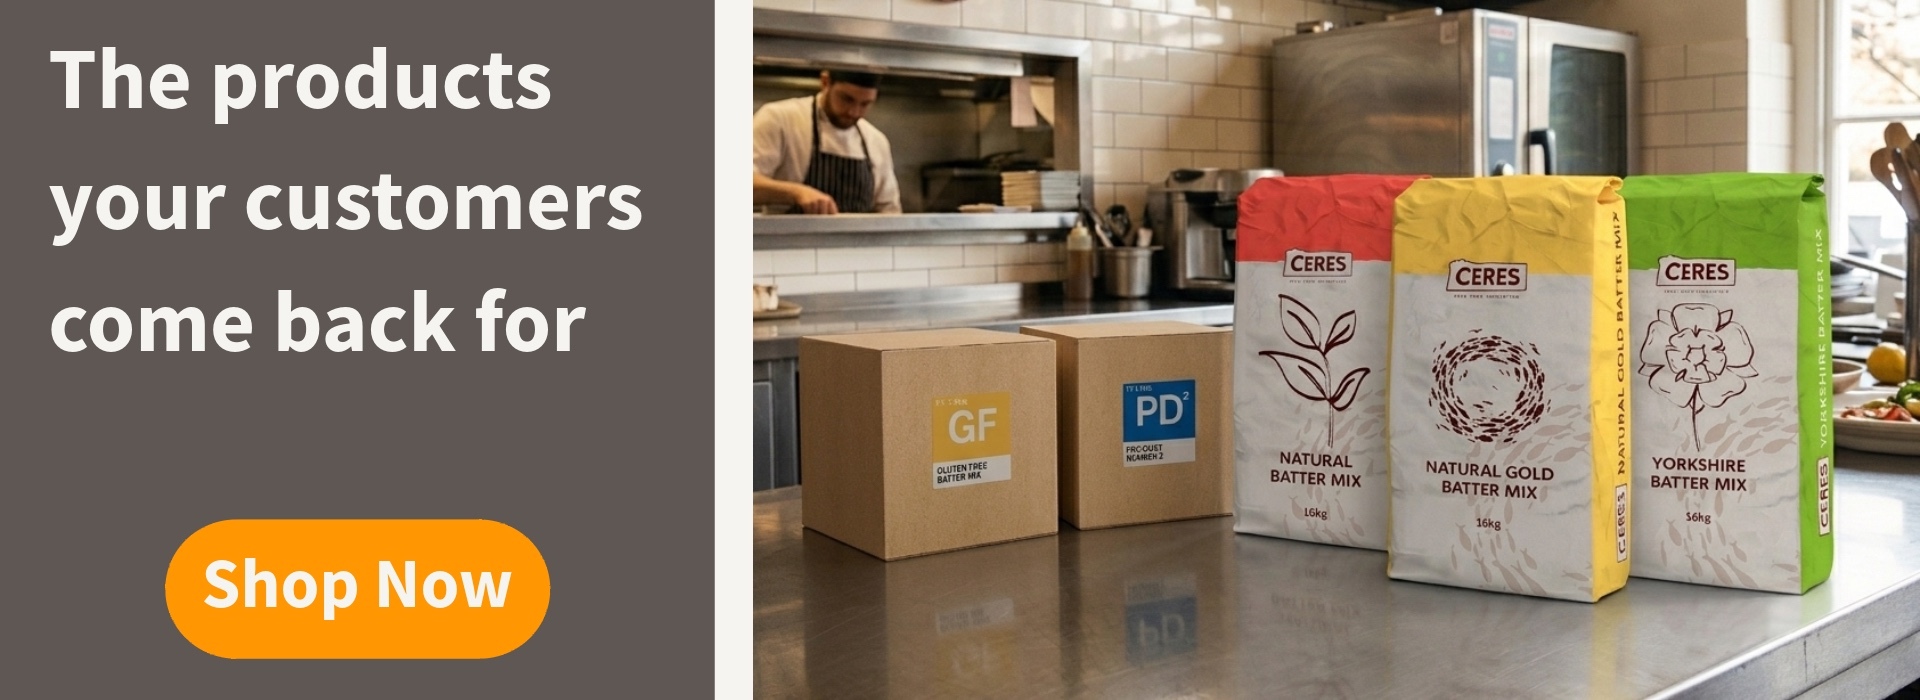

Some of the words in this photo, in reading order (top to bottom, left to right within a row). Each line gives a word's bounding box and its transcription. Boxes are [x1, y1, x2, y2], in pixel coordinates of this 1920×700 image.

[1290, 254, 1347, 272] CERES
[1665, 261, 1730, 281] CERES
[1455, 266, 1521, 286] CERES
[948, 407, 998, 444] GF
[1279, 451, 1354, 468] NATURAL
[1651, 456, 1747, 473] YORKSHIRE
[936, 473, 966, 484] BATTER
[1270, 469, 1326, 486] BATTER
[1331, 473, 1362, 488] MIX
[1425, 460, 1502, 478] NATURAL
[1505, 465, 1555, 481] GOLD
[1441, 480, 1500, 497] BATTER
[1504, 484, 1538, 500] MIX
[1650, 475, 1709, 490] BATTER
[1715, 478, 1748, 492] MIX
[1476, 518, 1502, 532] 16kg
